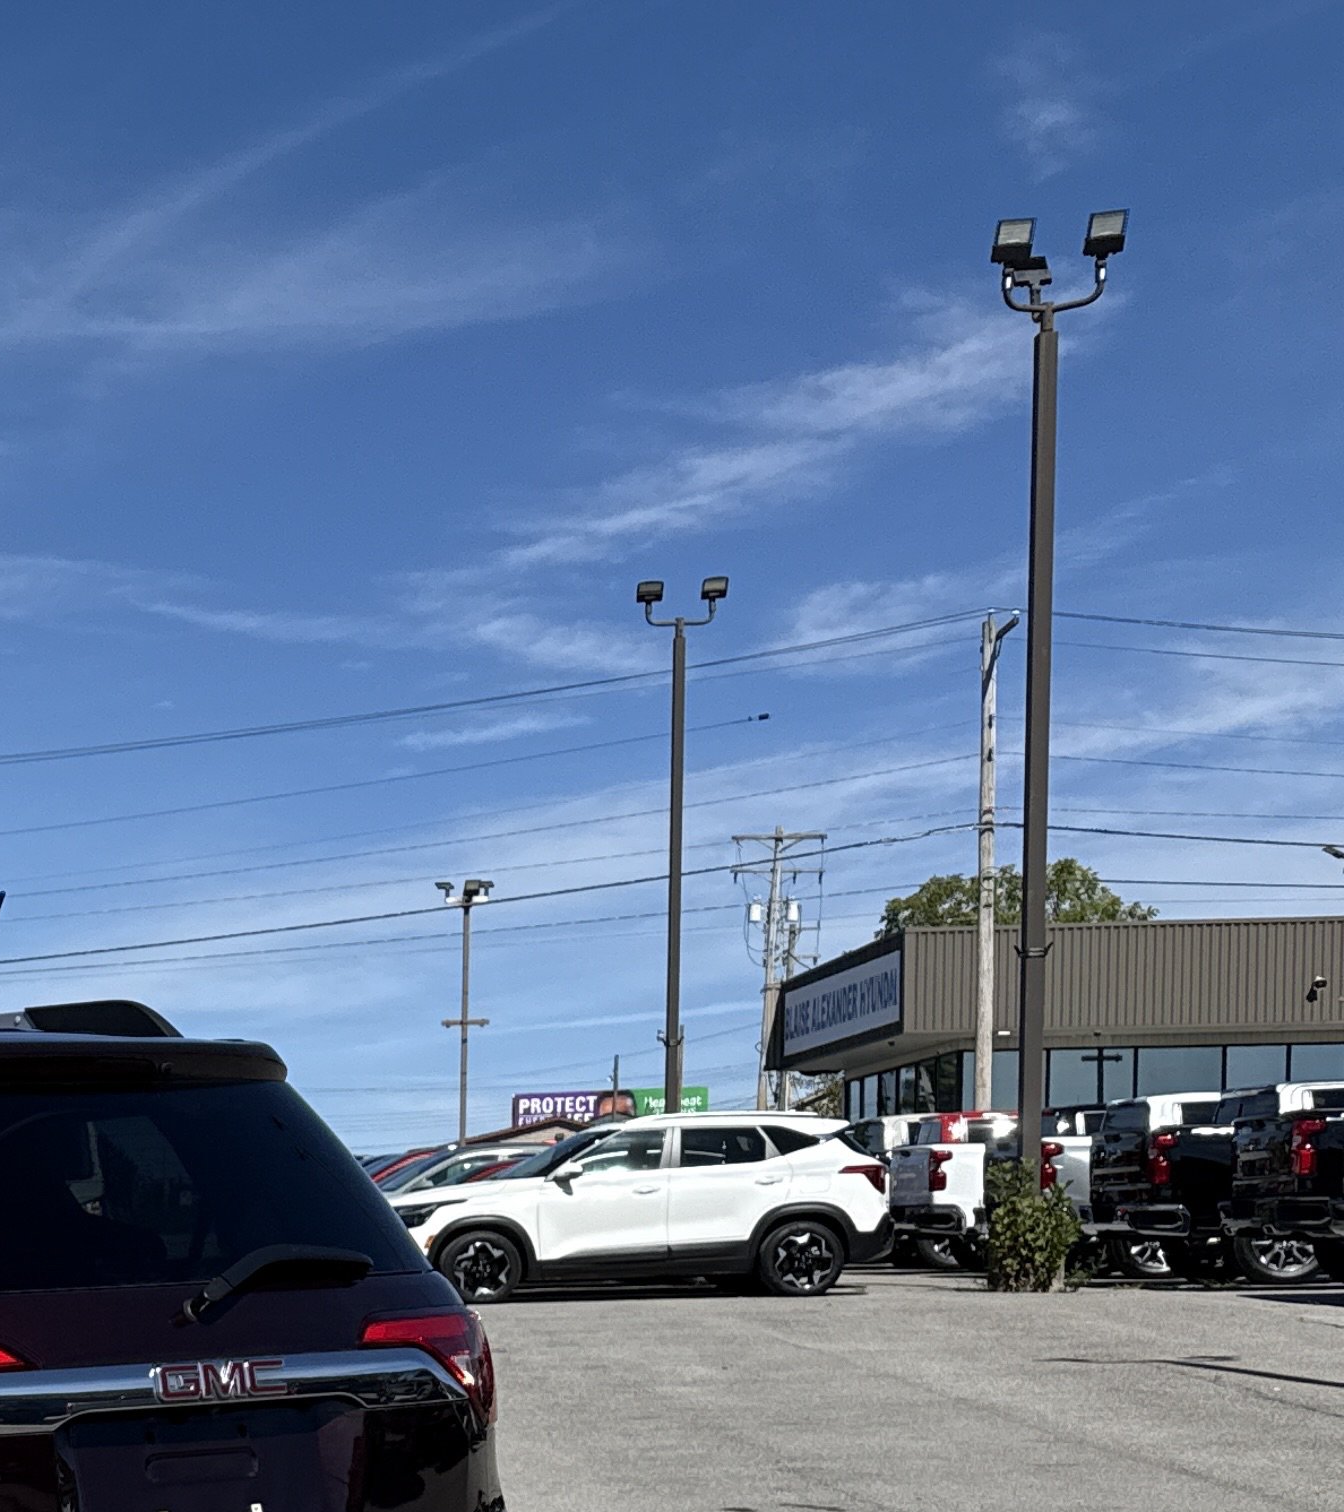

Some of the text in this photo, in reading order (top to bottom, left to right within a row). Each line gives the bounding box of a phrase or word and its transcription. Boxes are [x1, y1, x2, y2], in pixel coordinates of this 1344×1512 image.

[785, 968, 898, 1041] BLAISE ALEXANDER HYUNDAI
[518, 1096, 598, 1114] PROTECT
[152, 1359, 288, 1402] GMC
